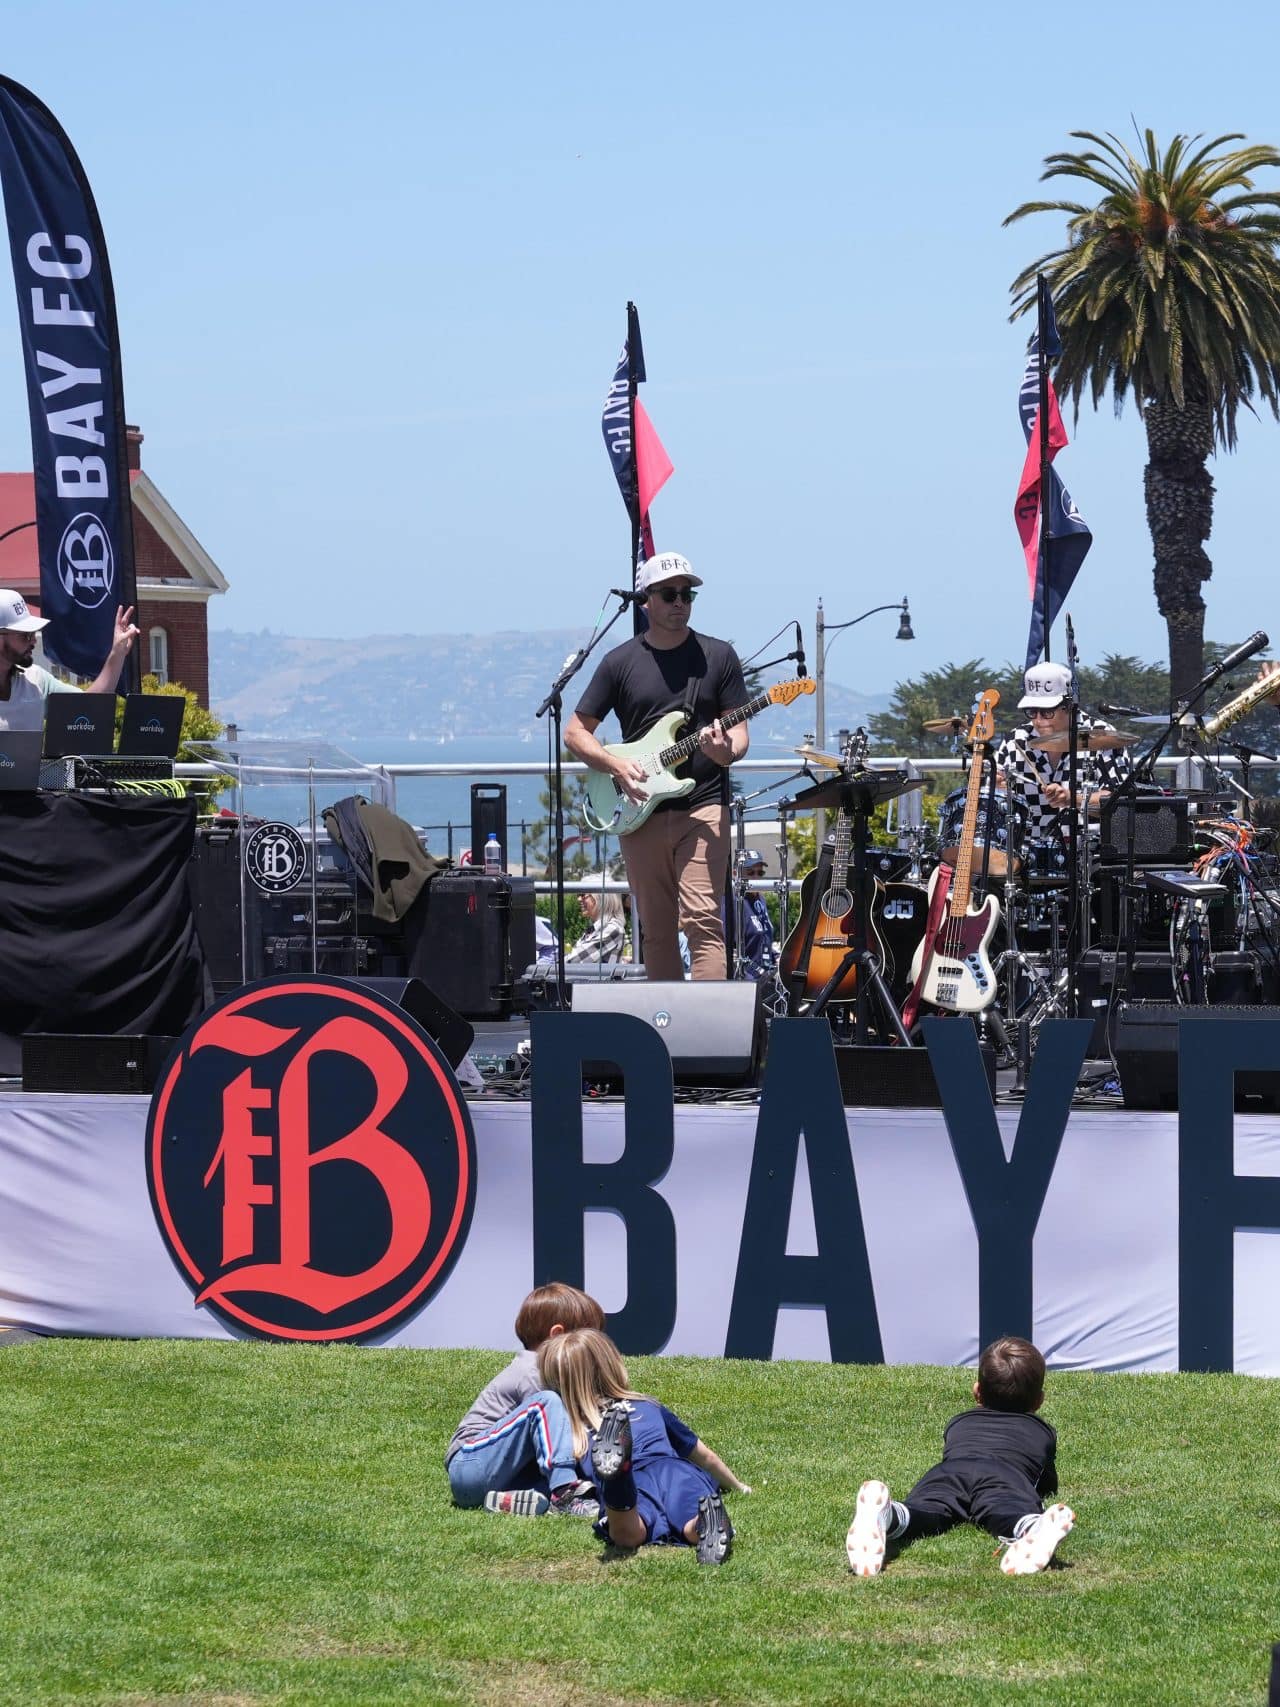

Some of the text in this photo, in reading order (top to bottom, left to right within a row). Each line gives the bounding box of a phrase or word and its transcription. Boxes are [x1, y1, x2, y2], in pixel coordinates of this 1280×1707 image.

[26, 231, 109, 499] BAY FC
[607, 425, 631, 453] FC
[884, 899, 913, 919] dw
[531, 1012, 1094, 1365] BAY
